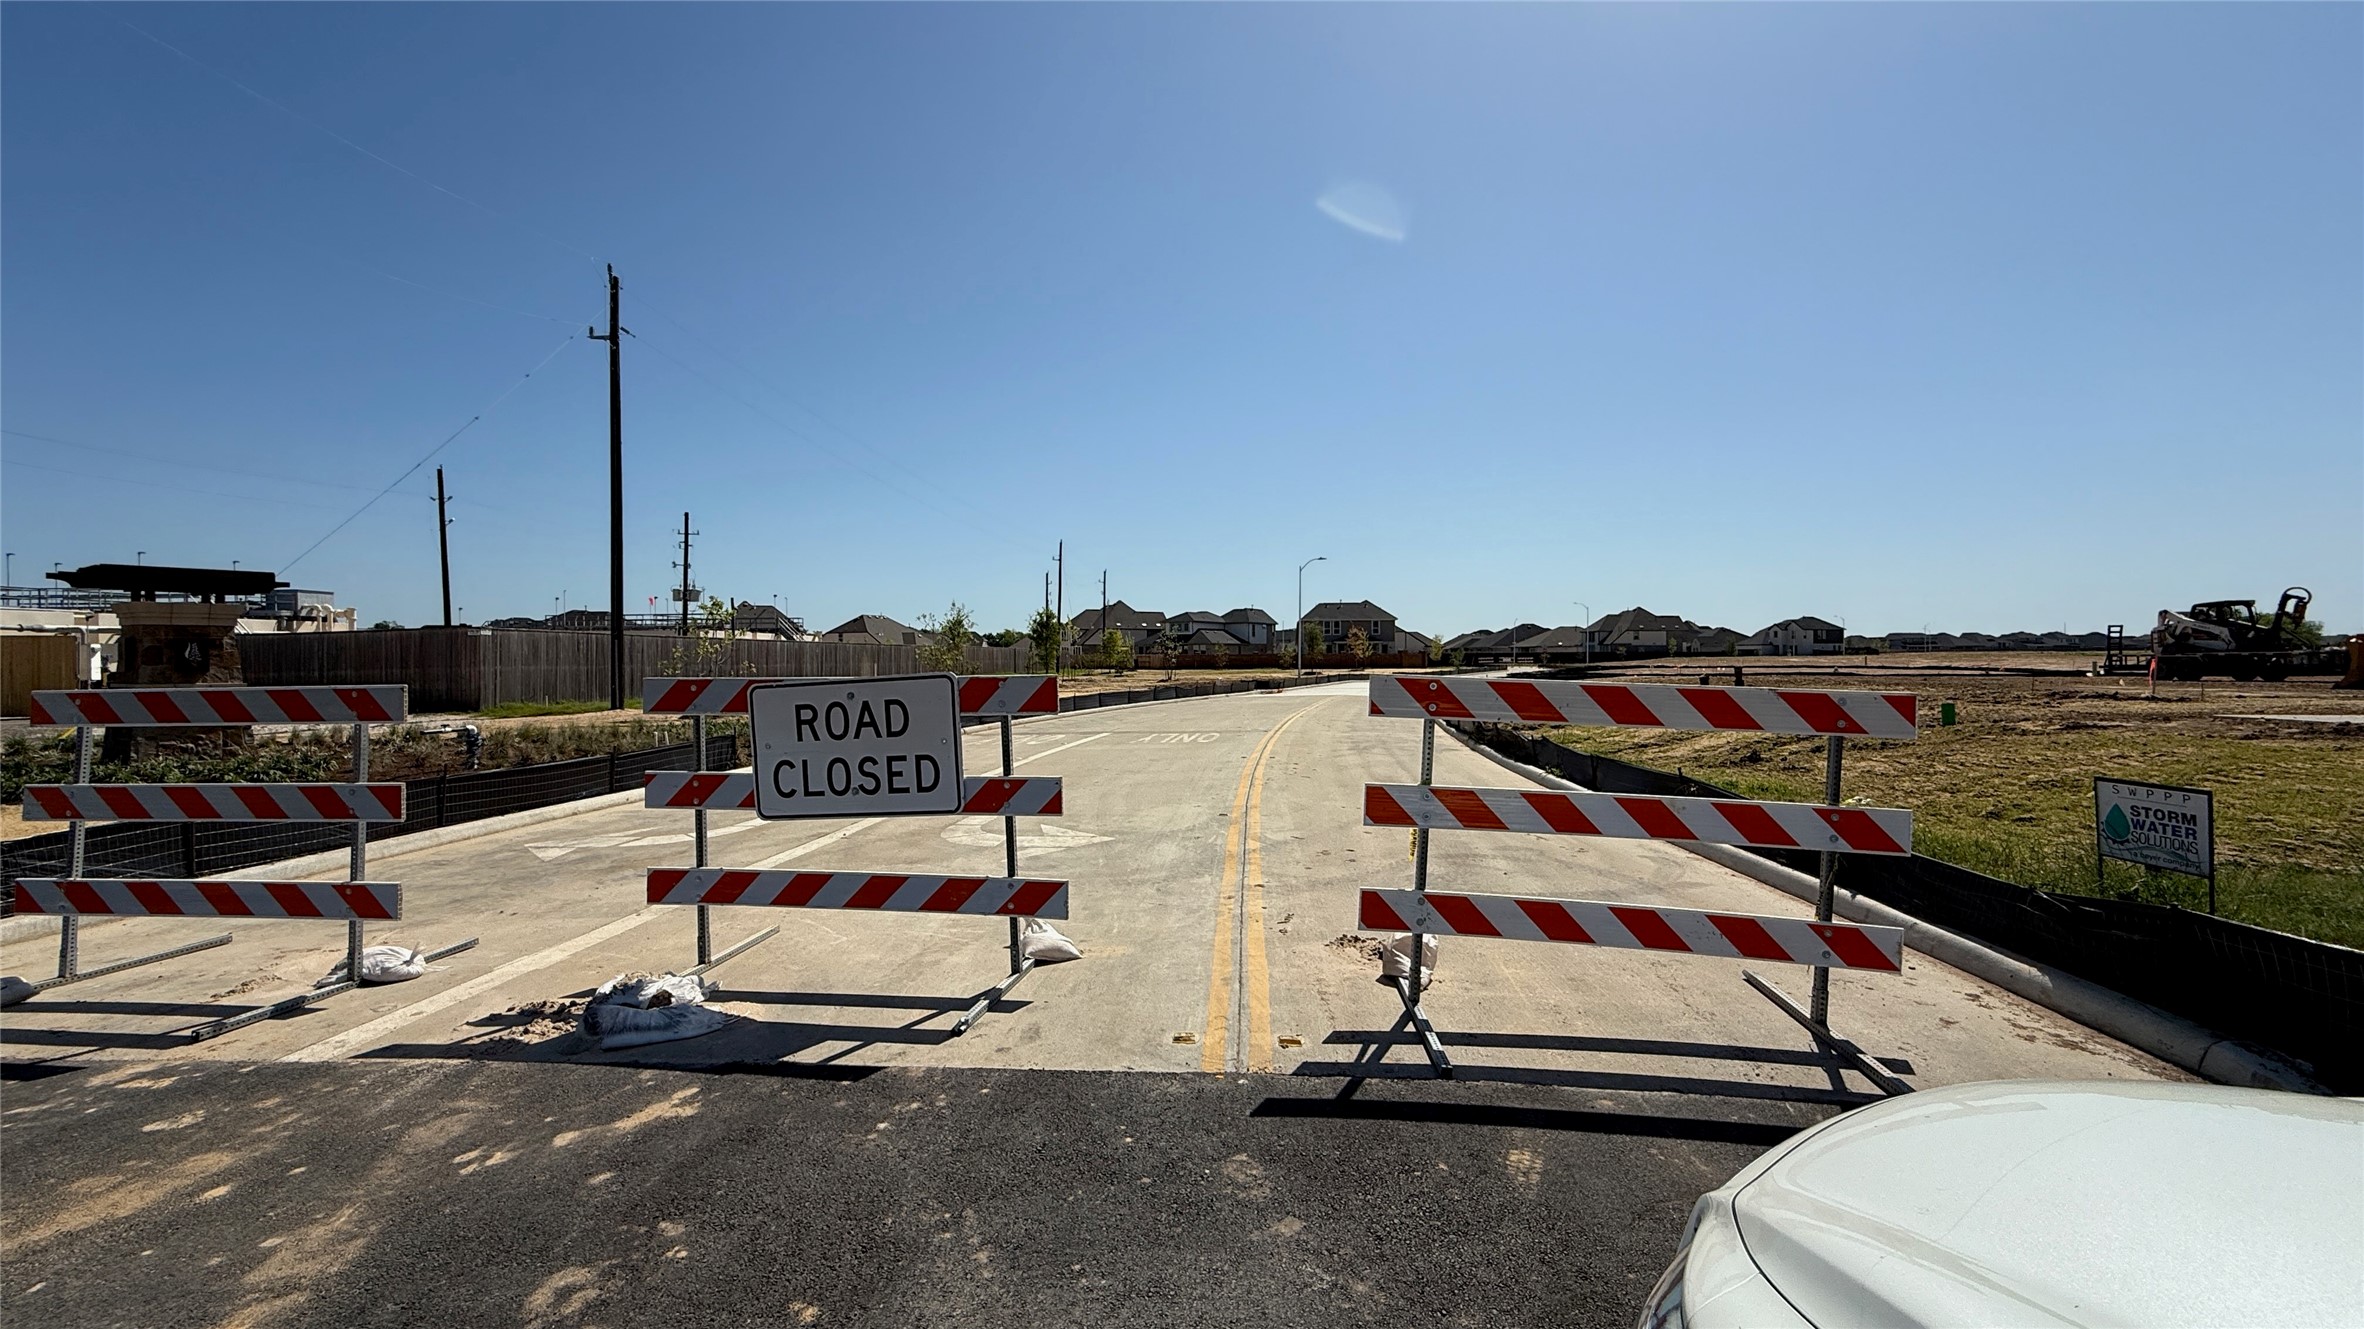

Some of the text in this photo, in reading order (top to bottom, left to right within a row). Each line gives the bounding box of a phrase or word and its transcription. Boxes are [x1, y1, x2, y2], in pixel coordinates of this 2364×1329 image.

[795, 699, 910, 742] ROAD
[1128, 732, 1220, 743] ONLY
[773, 754, 941, 798] CLOSED
[2130, 805, 2198, 827] STORM
[2130, 818, 2198, 840] WATER
[2131, 831, 2199, 855] SOLUTIONS
